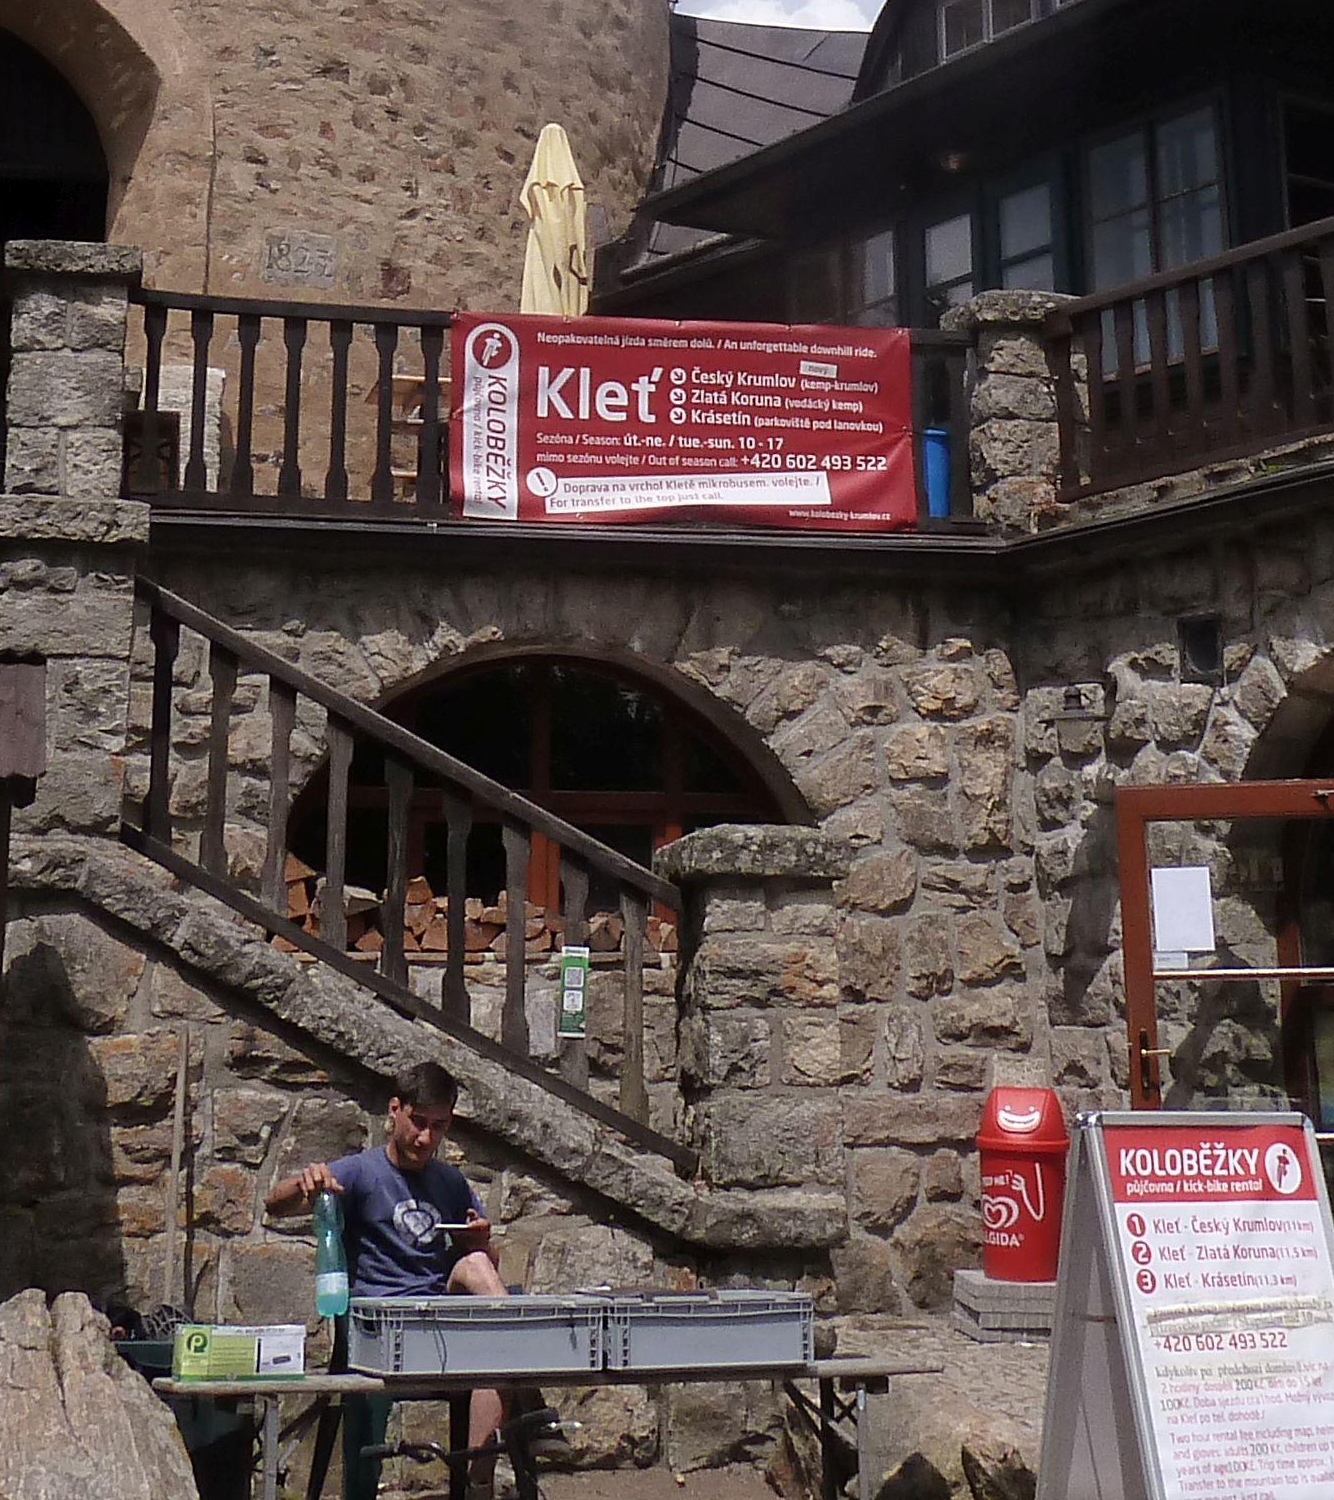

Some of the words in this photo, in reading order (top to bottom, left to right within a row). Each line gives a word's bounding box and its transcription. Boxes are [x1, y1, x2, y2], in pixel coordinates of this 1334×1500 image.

[537, 332, 619, 346] Neopakovatelná
[621, 334, 645, 347] jízda
[648, 335, 688, 348] směrem
[724, 340, 738, 350] An
[740, 340, 809, 354] unforgettable
[810, 344, 853, 356] downhill
[854, 346, 877, 358] ride.
[691, 366, 733, 388] Český
[737, 371, 796, 388] Krumlov
[801, 379, 878, 394] (kemp-krumlov)
[537, 365, 663, 423] Kleť
[691, 389, 727, 405] Zlatá
[732, 391, 781, 407] Koruna
[785, 398, 830, 412] (vodácký
[832, 399, 863, 413] kemp)
[691, 408, 751, 425] Krásetín
[754, 415, 811, 429] (parkoviště
[812, 417, 832, 431] pod
[834, 419, 883, 433] lanovkou)
[486, 374, 511, 510] KOLOBĚŽKY
[536, 432, 573, 445] Sezóna
[582, 433, 621, 446] Season:
[738, 437, 755, 450] 10
[768, 437, 784, 450] 17
[536, 452, 564, 463] mimo
[566, 453, 603, 464] sezónu
[604, 454, 639, 467] volejte
[648, 454, 667, 466] Out
[668, 454, 679, 466] of
[681, 457, 717, 468] season
[741, 453, 782, 469] +420
[786, 454, 817, 470] 602
[821, 455, 851, 470] 493
[856, 456, 887, 471] 522
[563, 482, 610, 495] Doprava
[612, 483, 626, 493] na
[628, 480, 663, 492] vrchol
[665, 479, 696, 491] Kletě
[549, 498, 568, 508] For
[570, 495, 616, 508] transfer
[619, 495, 632, 504] to
[634, 494, 655, 503] the
[656, 494, 675, 505] top
[677, 492, 700, 503] just
[1120, 1142, 1259, 1177] KOLOBĚŽKY
[1127, 1180, 1174, 1196] půjčovna
[1183, 1179, 1229, 1193] kick-bike
[1231, 1178, 1263, 1192] rental
[1153, 1218, 1181, 1234] Kleť
[1191, 1215, 1230, 1236] Český
[1233, 1217, 1284, 1233] Krumlov
[1158, 1246, 1186, 1262] Kleť
[1197, 1245, 1230, 1260] Zlatá
[1234, 1244, 1276, 1261] Koruna
[1164, 1273, 1192, 1289] Kleť
[1202, 1272, 1255, 1289] Krásetín
[1154, 1335, 1192, 1352] +420
[1196, 1333, 1224, 1351] 602
[1229, 1333, 1257, 1350] 493
[1259, 1331, 1288, 1349] 522
[1178, 1479, 1214, 1492] Transfer
[1216, 1478, 1226, 1489] to
